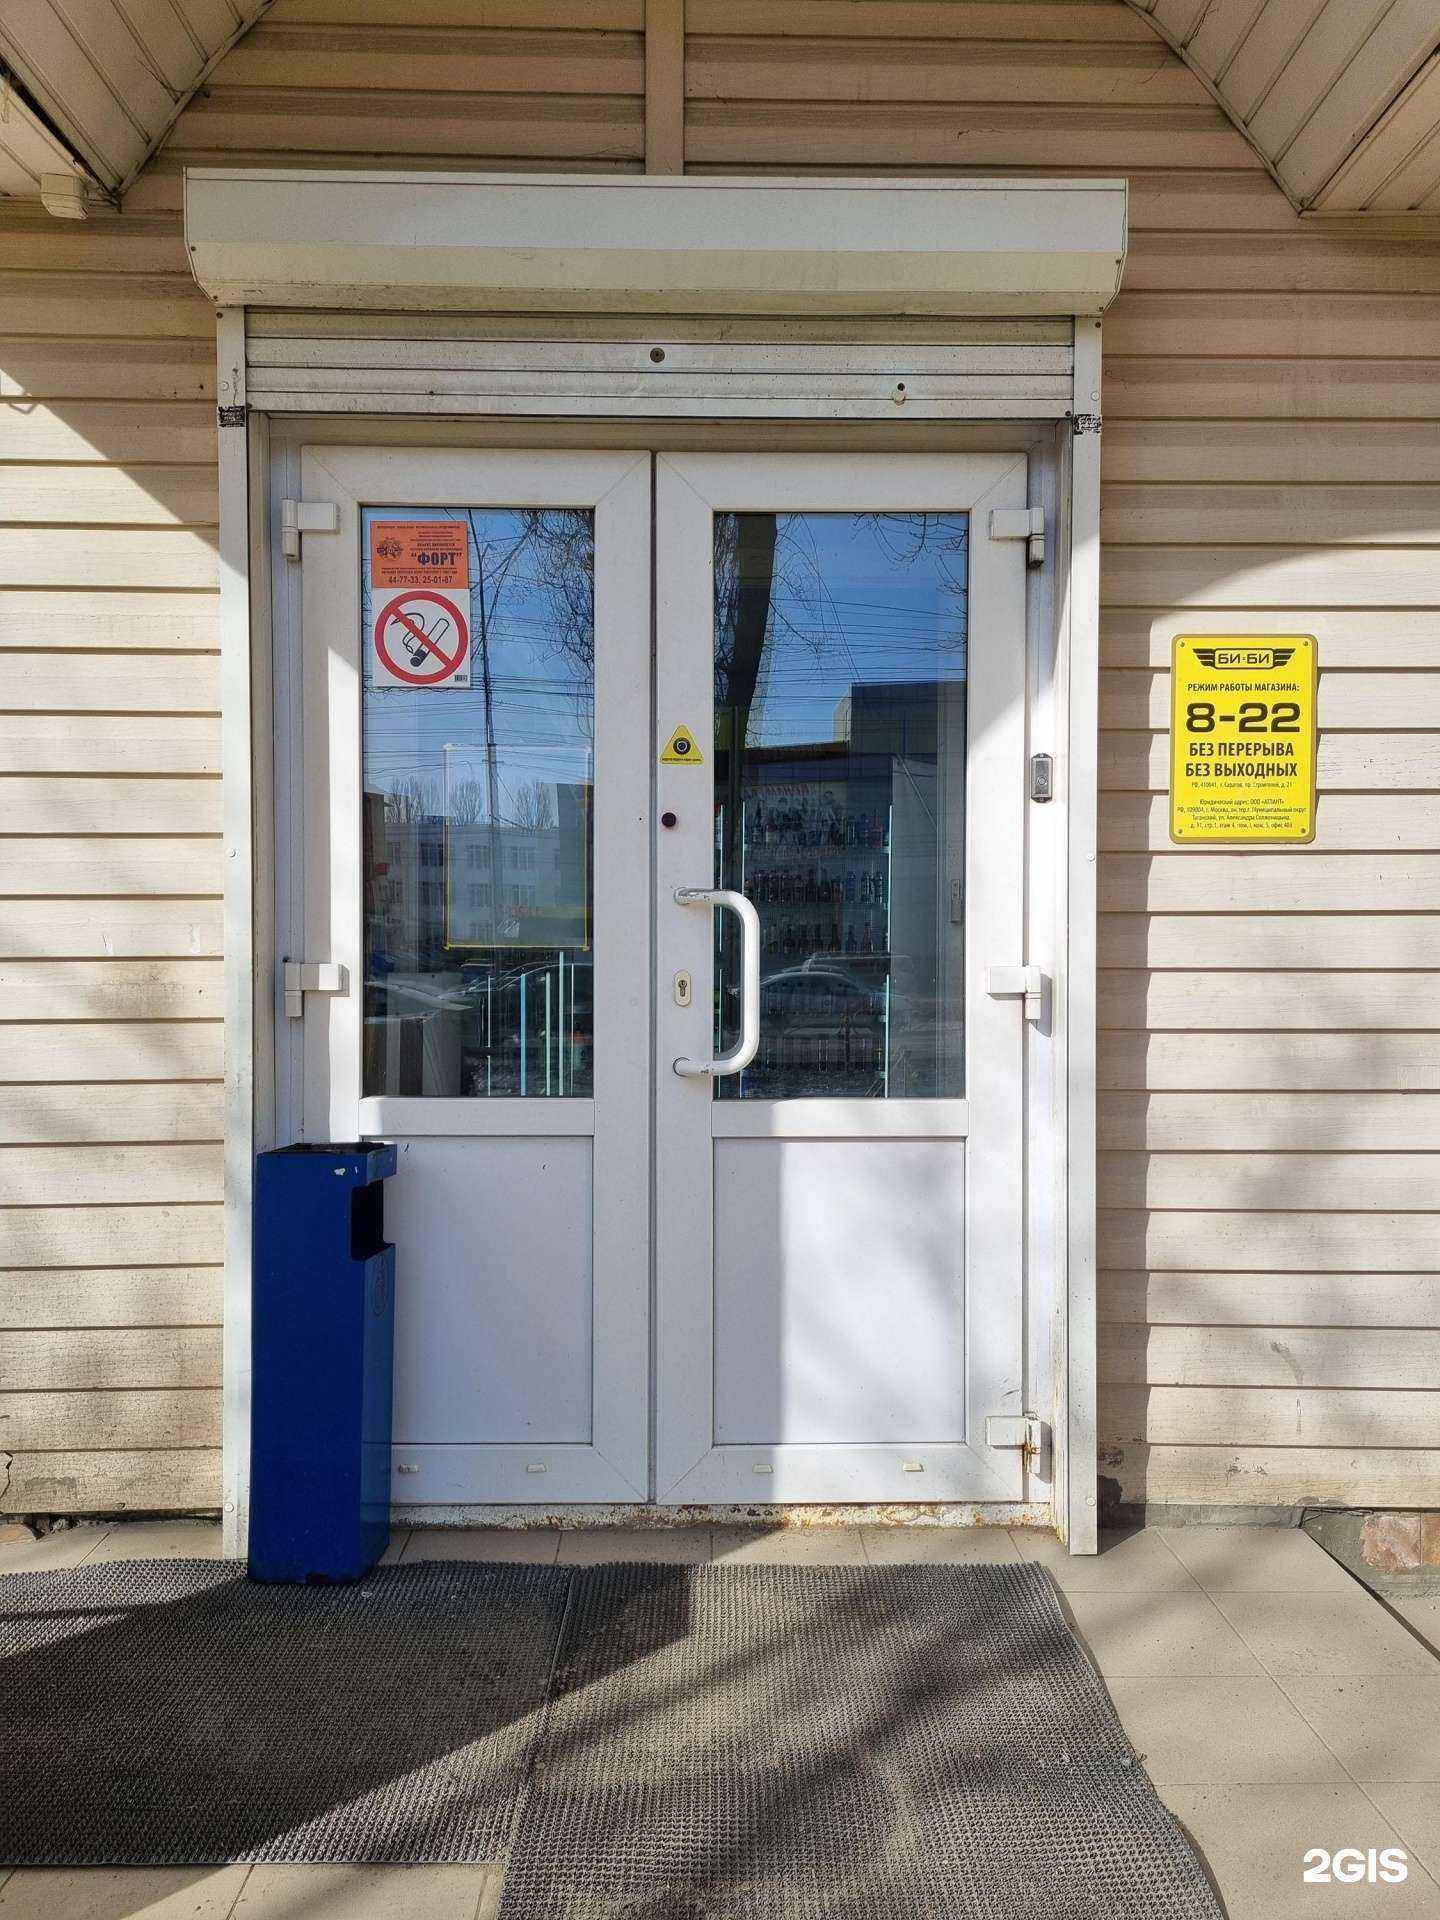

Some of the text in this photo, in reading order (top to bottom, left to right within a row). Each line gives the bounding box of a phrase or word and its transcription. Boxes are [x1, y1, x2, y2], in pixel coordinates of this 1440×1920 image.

[1217, 653, 1270, 665] БИ-БИ
[1187, 683, 1300, 692] РЕЖИМ РАБОТЫ МАГАЗИНА:
[1189, 742, 1295, 757] БЕЗ ПЕРЕРЫВА
[1185, 763, 1298, 779] БЕЗ ВЫХОДНЫХ
